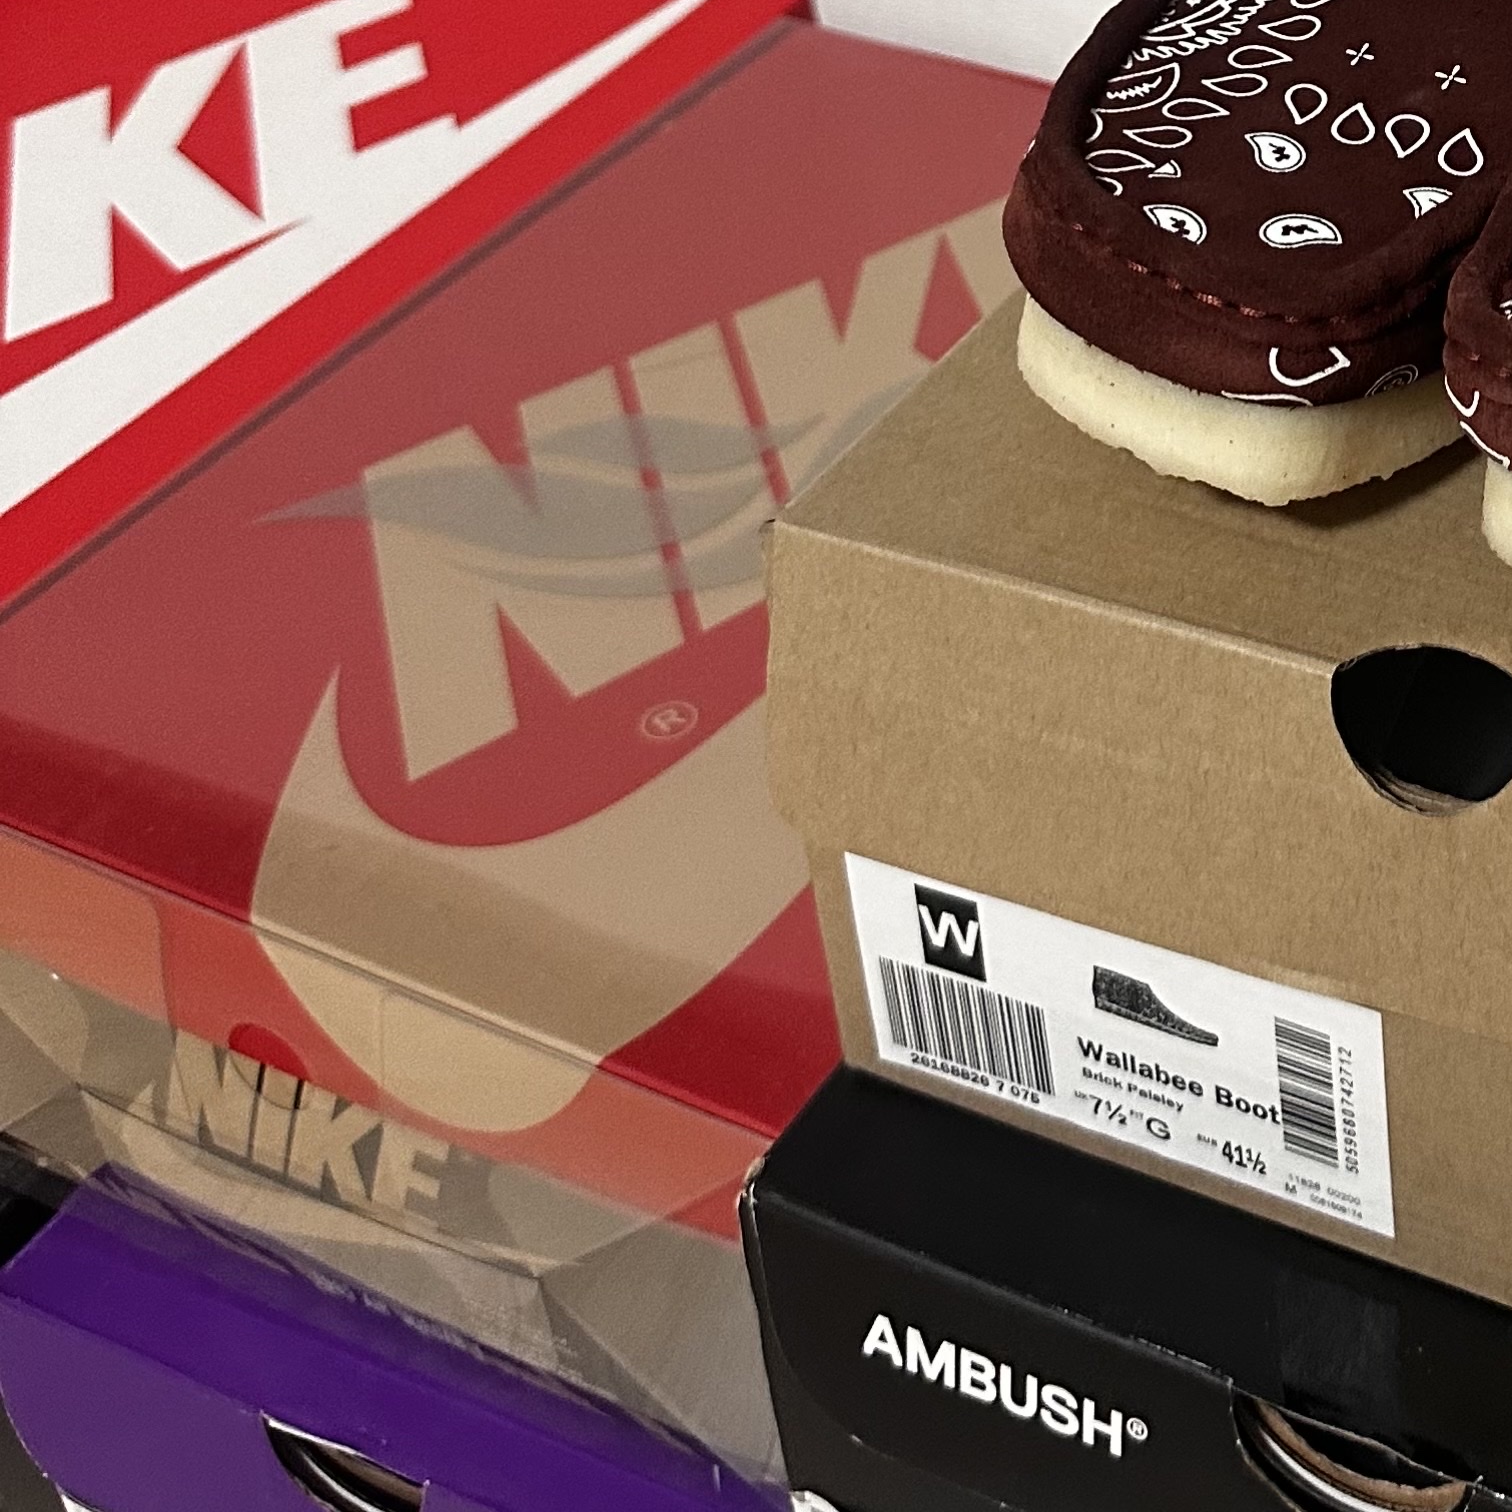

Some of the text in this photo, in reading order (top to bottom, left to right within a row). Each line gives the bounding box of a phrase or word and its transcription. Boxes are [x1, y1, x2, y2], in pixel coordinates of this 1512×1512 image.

[361, 191, 1022, 784] NIK
[917, 904, 980, 958] W
[1076, 1035, 1281, 1126] Wallabee Boot
[1082, 1066, 1185, 1115] Brick Paisley
[1145, 1116, 1172, 1141] G
